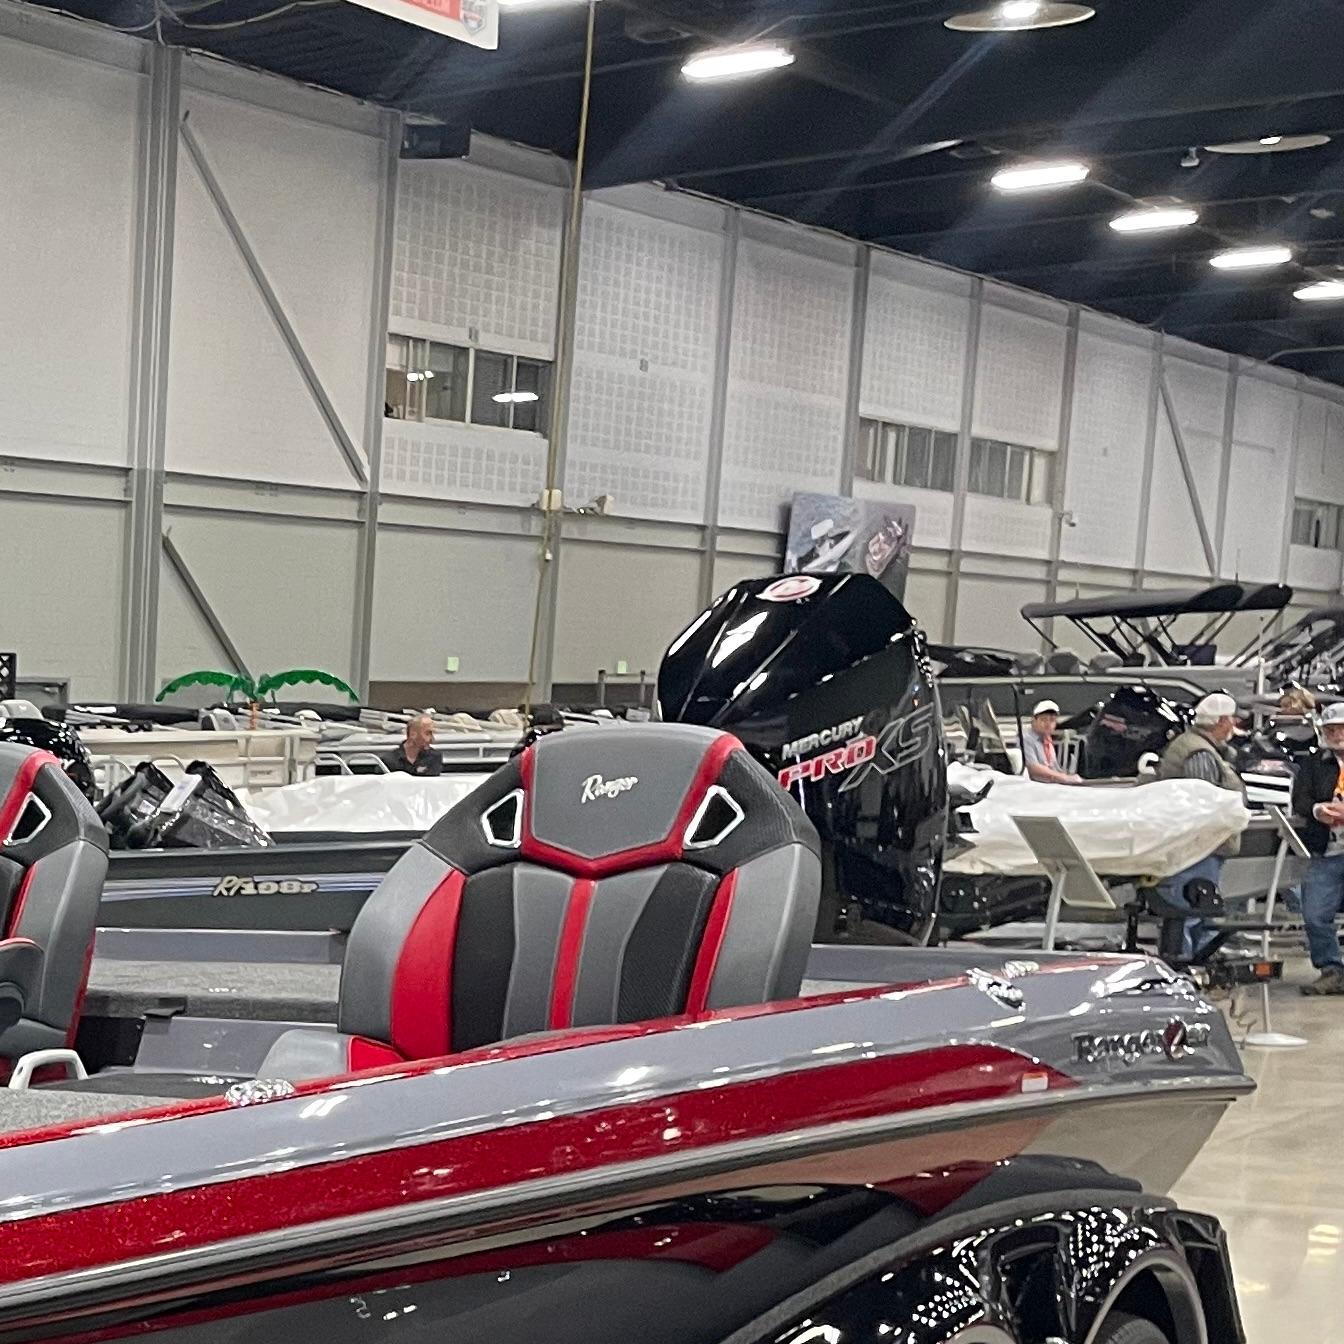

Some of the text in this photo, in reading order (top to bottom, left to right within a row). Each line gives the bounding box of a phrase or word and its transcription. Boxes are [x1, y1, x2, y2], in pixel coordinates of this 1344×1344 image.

[781, 705, 864, 760] MERCURY
[581, 774, 639, 803] Ranger
[778, 735, 877, 791] PRO
